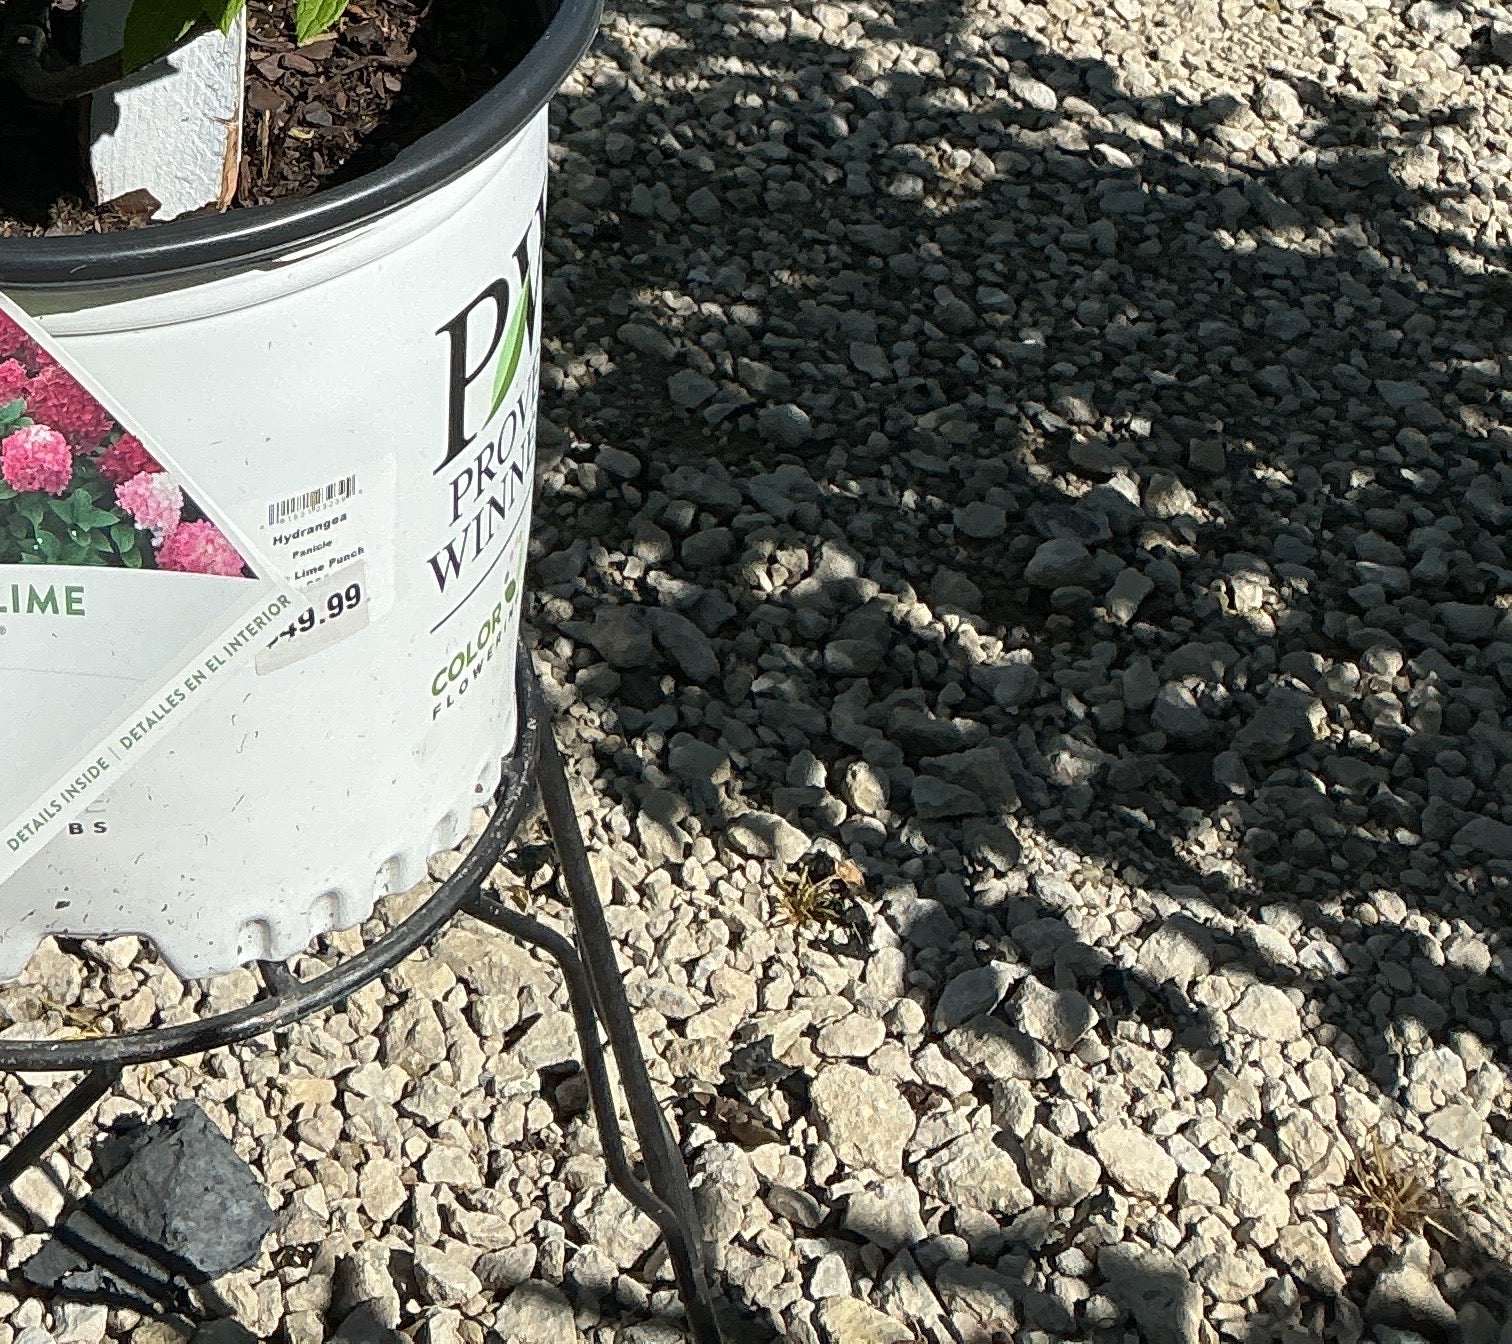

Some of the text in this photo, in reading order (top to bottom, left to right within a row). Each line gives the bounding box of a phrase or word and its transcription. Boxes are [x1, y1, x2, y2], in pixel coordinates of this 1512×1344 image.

[449, 348, 540, 528] PROVE
[272, 512, 348, 546] Hydrangea
[292, 540, 333, 560] Panicle
[294, 564, 325, 581] Lime
[328, 546, 365, 568] Punch
[431, 601, 502, 697] COLOR
[6, 593, 293, 852] DETAILS INSIDE DETALLES EN EL INTERIOR
